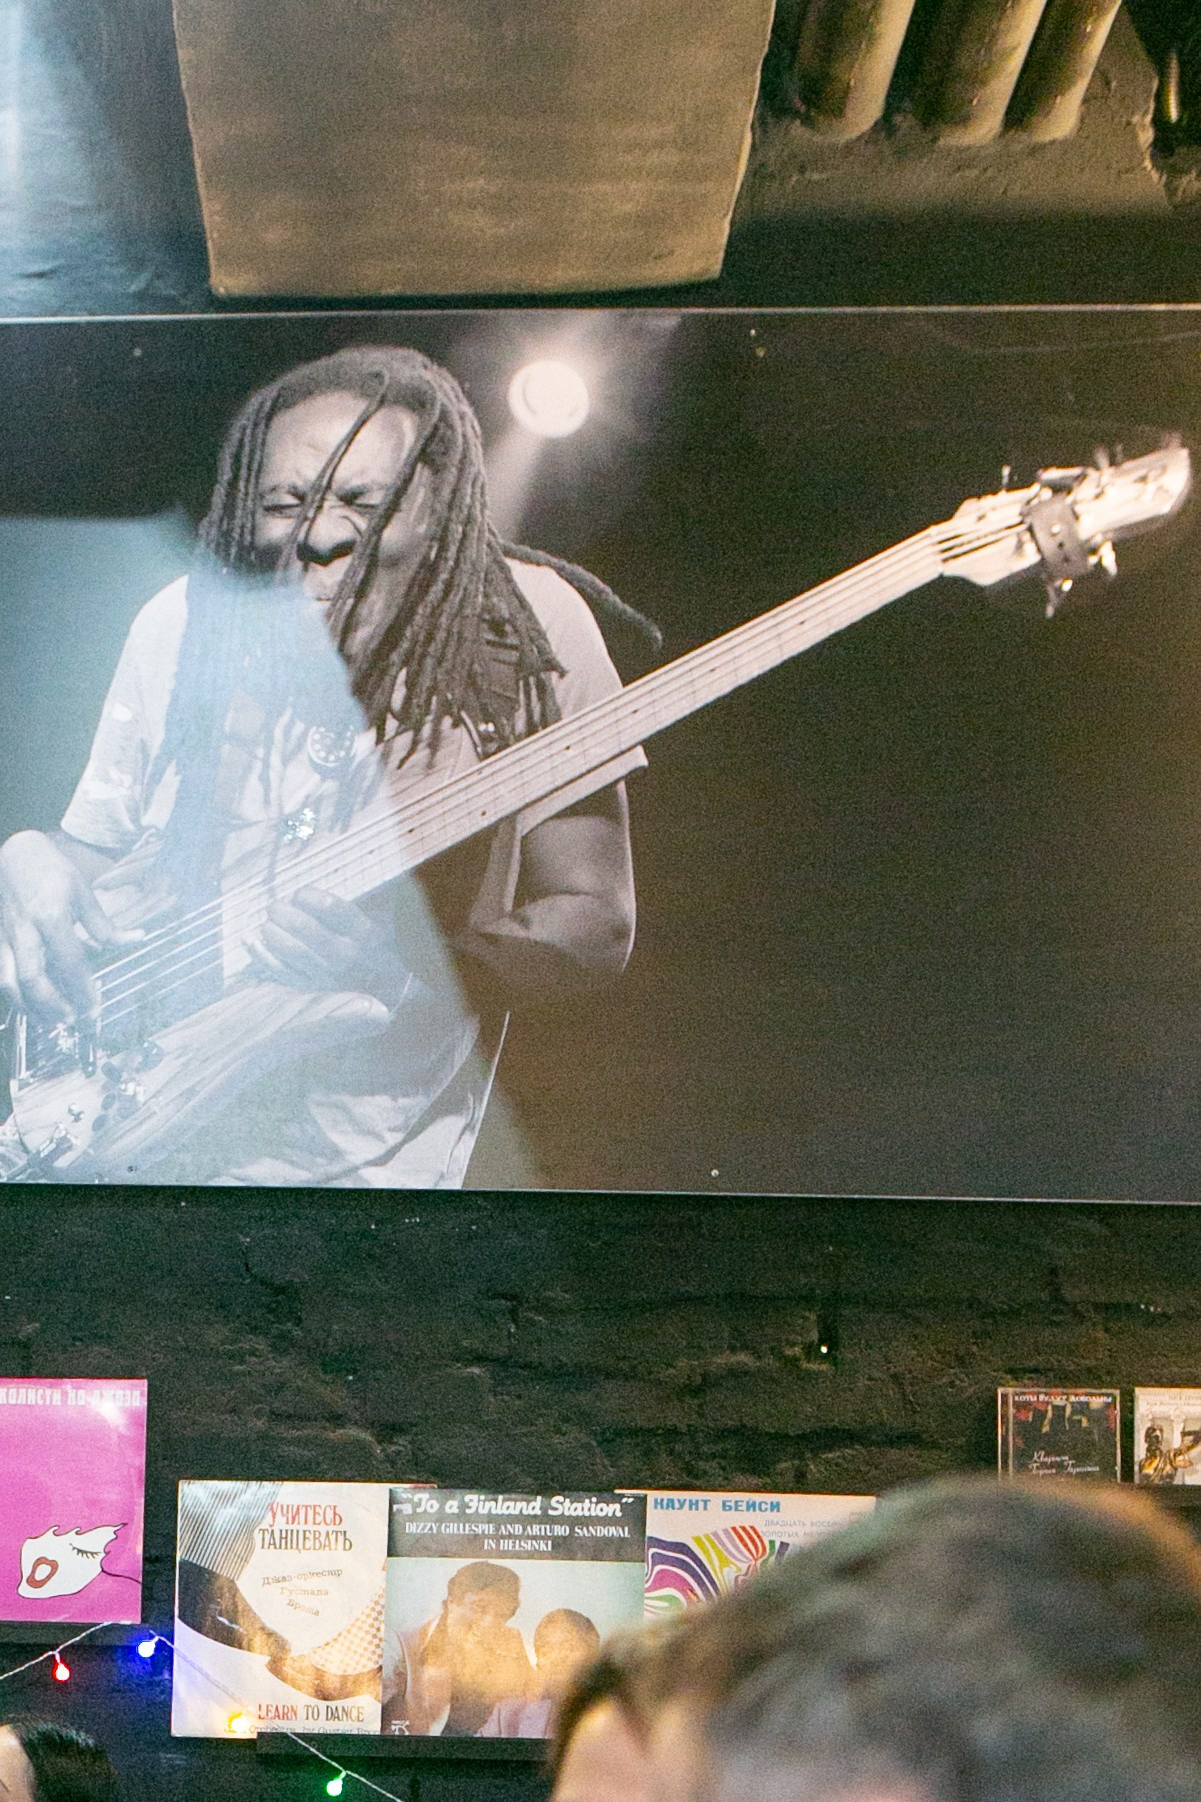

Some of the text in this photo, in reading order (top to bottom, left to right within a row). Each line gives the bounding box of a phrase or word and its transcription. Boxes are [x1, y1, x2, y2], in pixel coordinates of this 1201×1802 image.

[445, 1499, 459, 1514] a
[464, 1494, 542, 1515] Finland
[653, 1498, 781, 1512] КАУНТ БЕЙСИ
[268, 1501, 343, 1528] УЧИТЕСЬ
[764, 1519, 807, 1528] ДВАДЦАТЬ
[405, 1521, 631, 1538] DIZZY GILLESPIE AND ARTURO SANDOVAL
[258, 1528, 353, 1553] ТАНЦЕВАТЬ
[483, 1538, 552, 1551] IN HELSINKI
[258, 1703, 365, 1722] LEARN TO DANCE
